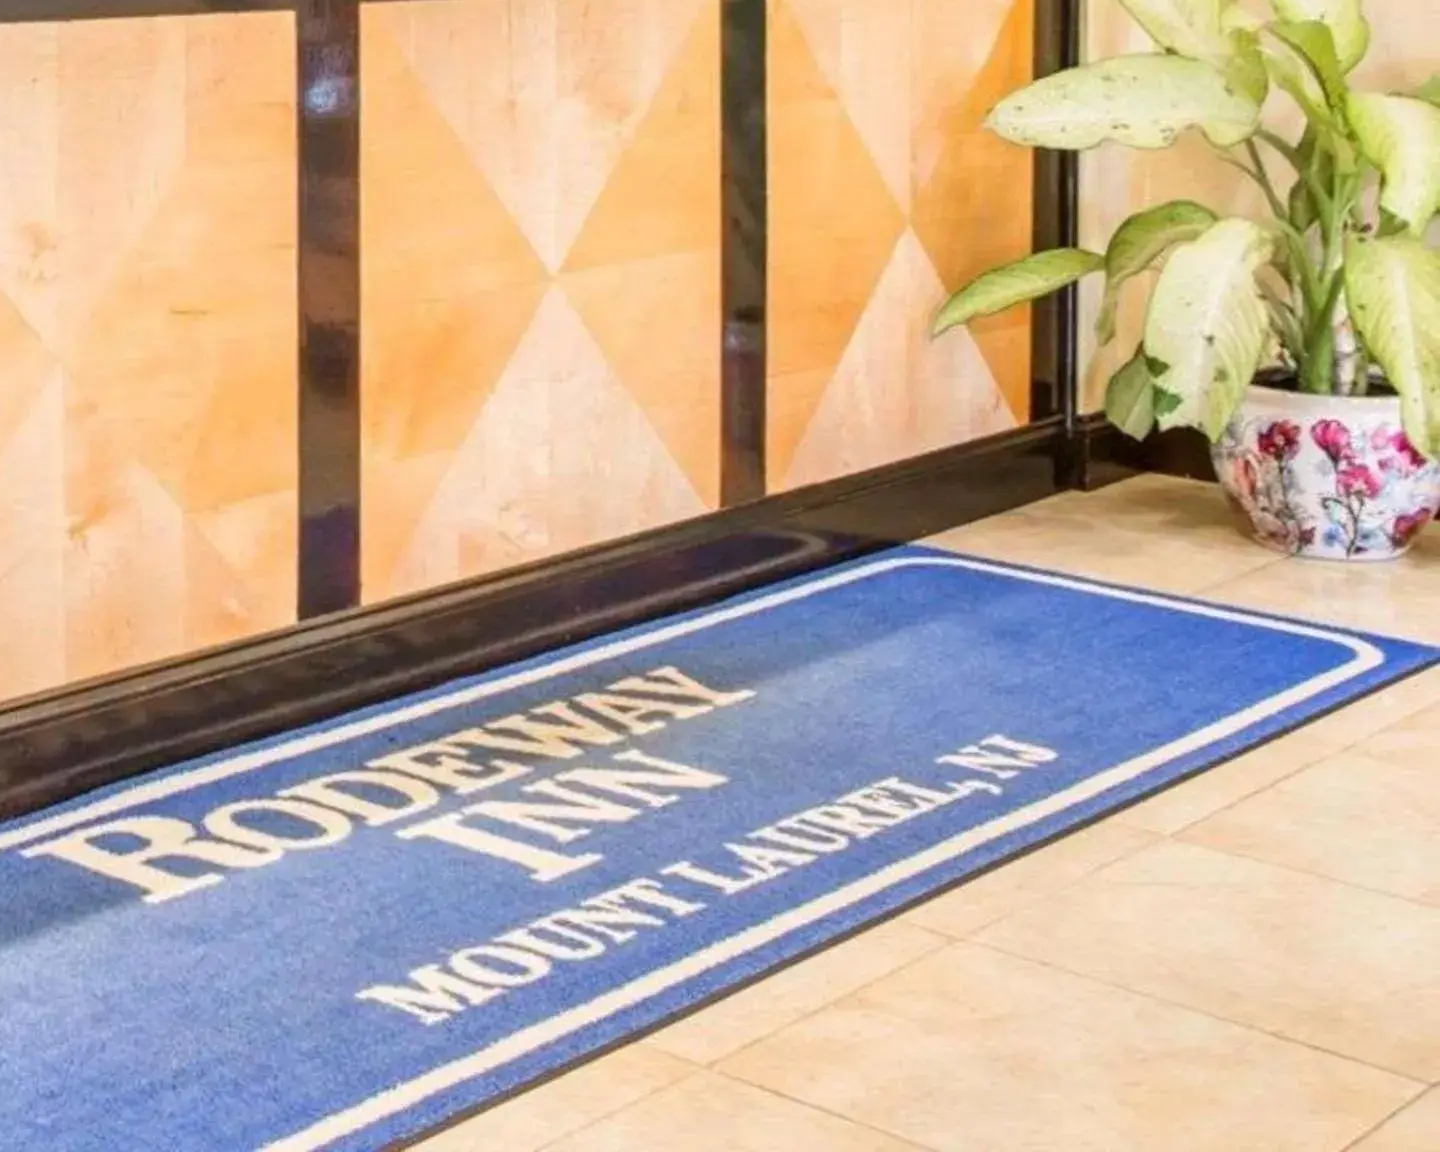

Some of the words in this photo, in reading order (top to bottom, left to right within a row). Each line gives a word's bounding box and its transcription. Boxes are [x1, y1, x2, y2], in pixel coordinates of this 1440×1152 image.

[19, 665, 757, 904] RODEWAY
[394, 749, 729, 883] INN
[354, 877, 707, 1026] MOUNT
